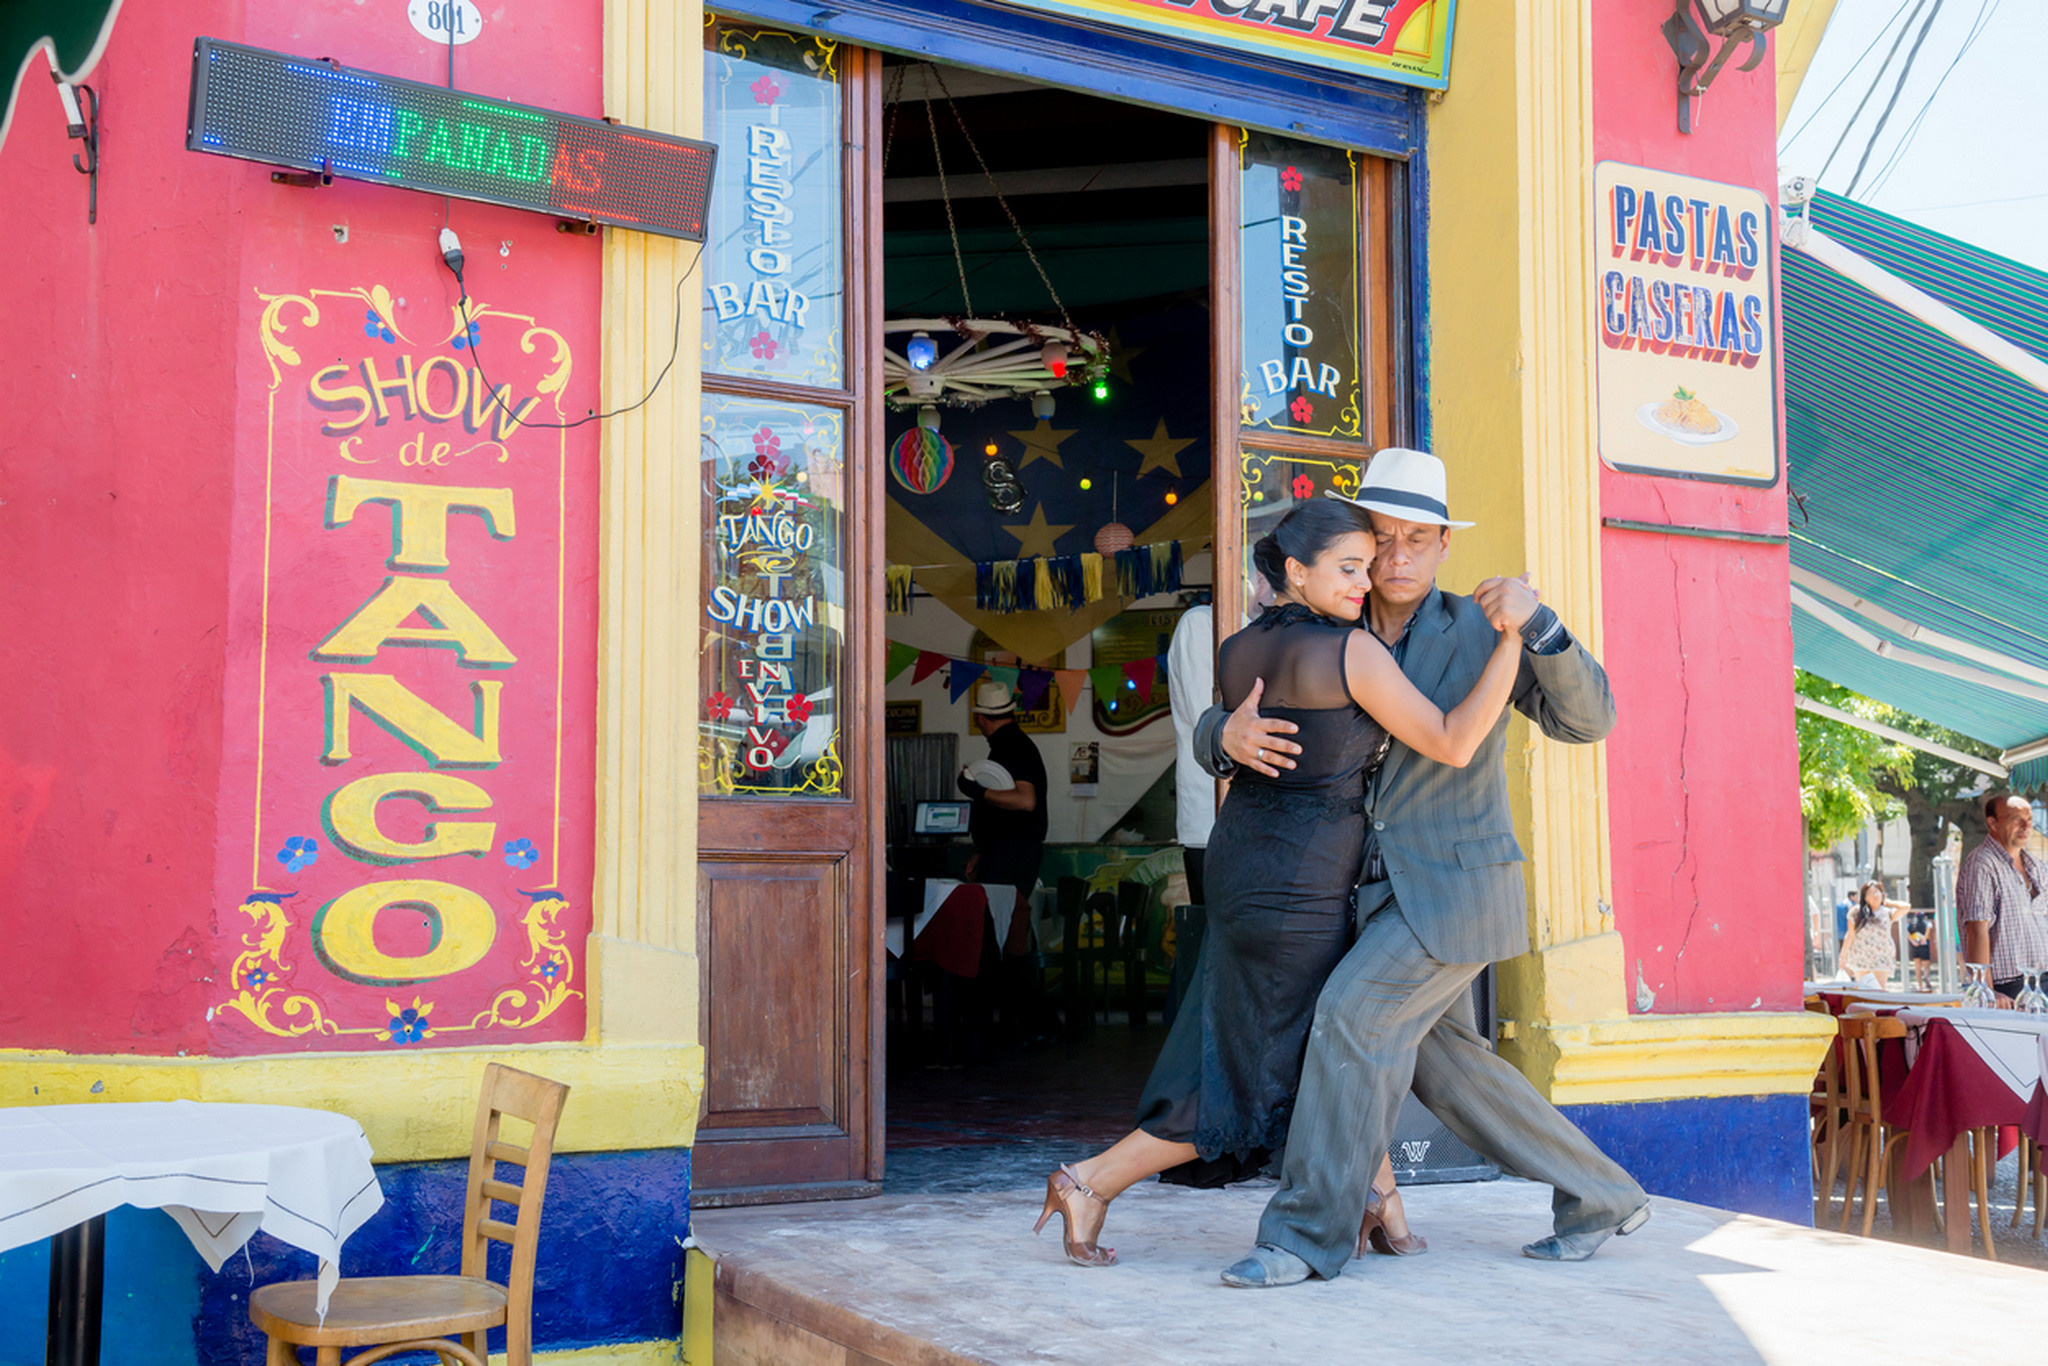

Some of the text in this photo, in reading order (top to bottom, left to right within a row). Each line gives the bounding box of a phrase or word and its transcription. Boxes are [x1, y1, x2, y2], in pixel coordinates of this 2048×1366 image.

[427, 0, 466, 35] 801
[326, 96, 605, 195] EMPANADAS
[747, 125, 786, 278] RESTO
[1609, 184, 1759, 282] PASTAS
[707, 281, 811, 330] BAR
[1280, 215, 1314, 348] RESTO
[1601, 270, 1764, 370] CASERAS
[307, 355, 541, 442] SHOW
[1259, 356, 1342, 399] BAR
[399, 433, 452, 469] de
[717, 511, 814, 556] TANGO
[706, 586, 814, 635] SHOW
[738, 659, 781, 681] EN
[307, 474, 518, 988] TANGO
[744, 682, 774, 772] VIVO
